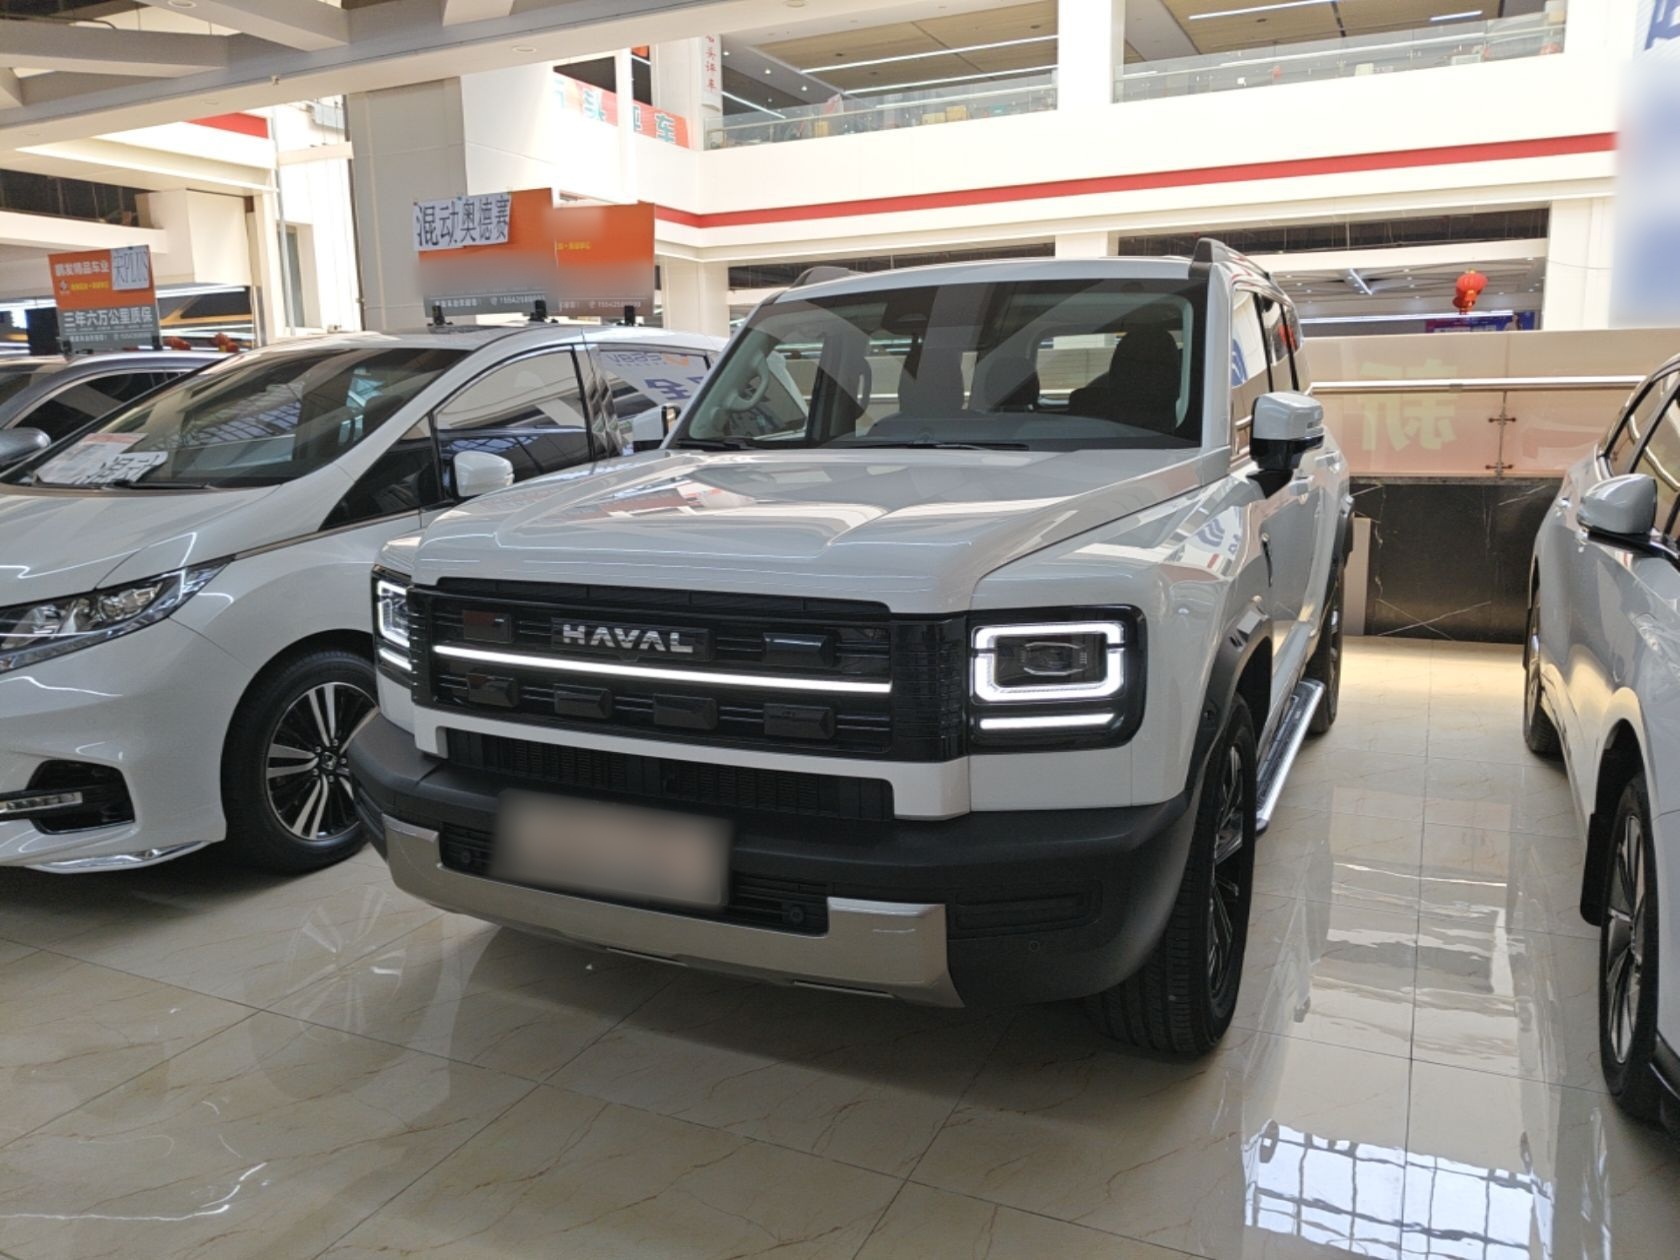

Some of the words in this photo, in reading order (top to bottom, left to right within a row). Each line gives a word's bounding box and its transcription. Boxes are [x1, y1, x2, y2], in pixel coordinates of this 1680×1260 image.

[415, 194, 510, 247] 混动奥德赛
[63, 306, 153, 328] 三年六万公里质保
[561, 623, 694, 654] HAVAL
